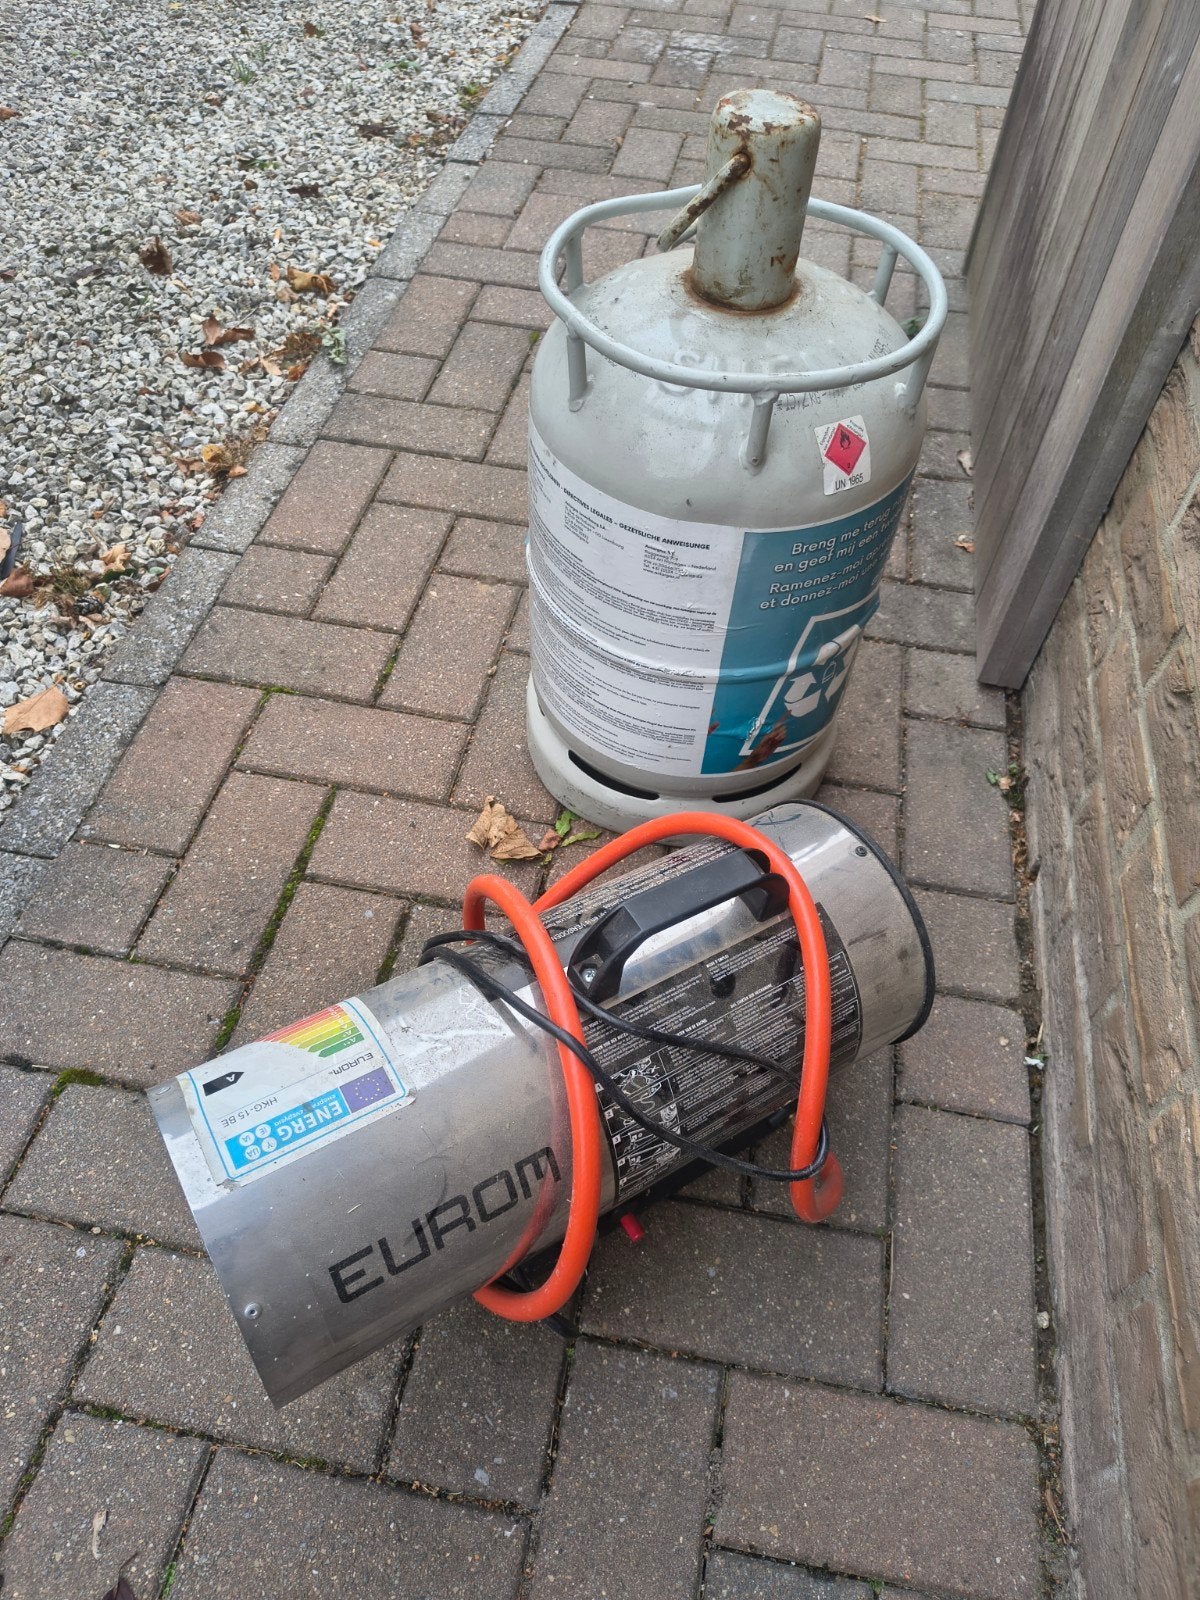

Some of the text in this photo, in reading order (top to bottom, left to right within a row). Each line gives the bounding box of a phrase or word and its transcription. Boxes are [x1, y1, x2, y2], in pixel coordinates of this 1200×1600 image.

[834, 473, 864, 491] UN 1965
[589, 507, 614, 524] LEGALES
[791, 536, 836, 556] Breng
[840, 528, 861, 543] me
[863, 507, 891, 531] terug
[774, 561, 793, 573] en
[798, 552, 834, 573] geef
[836, 541, 857, 559] mij
[858, 530, 879, 548] een
[759, 597, 776, 610] et
[780, 570, 860, 607] donnez-moi
[769, 556, 864, 594] Ramenez-moi
[225, 1073, 236, 1083] A
[332, 1051, 375, 1076] EUROM
[220, 1095, 279, 1129] HKG-15 BE
[276, 1102, 344, 1142] ENERG
[328, 1146, 561, 1304] EUROM
